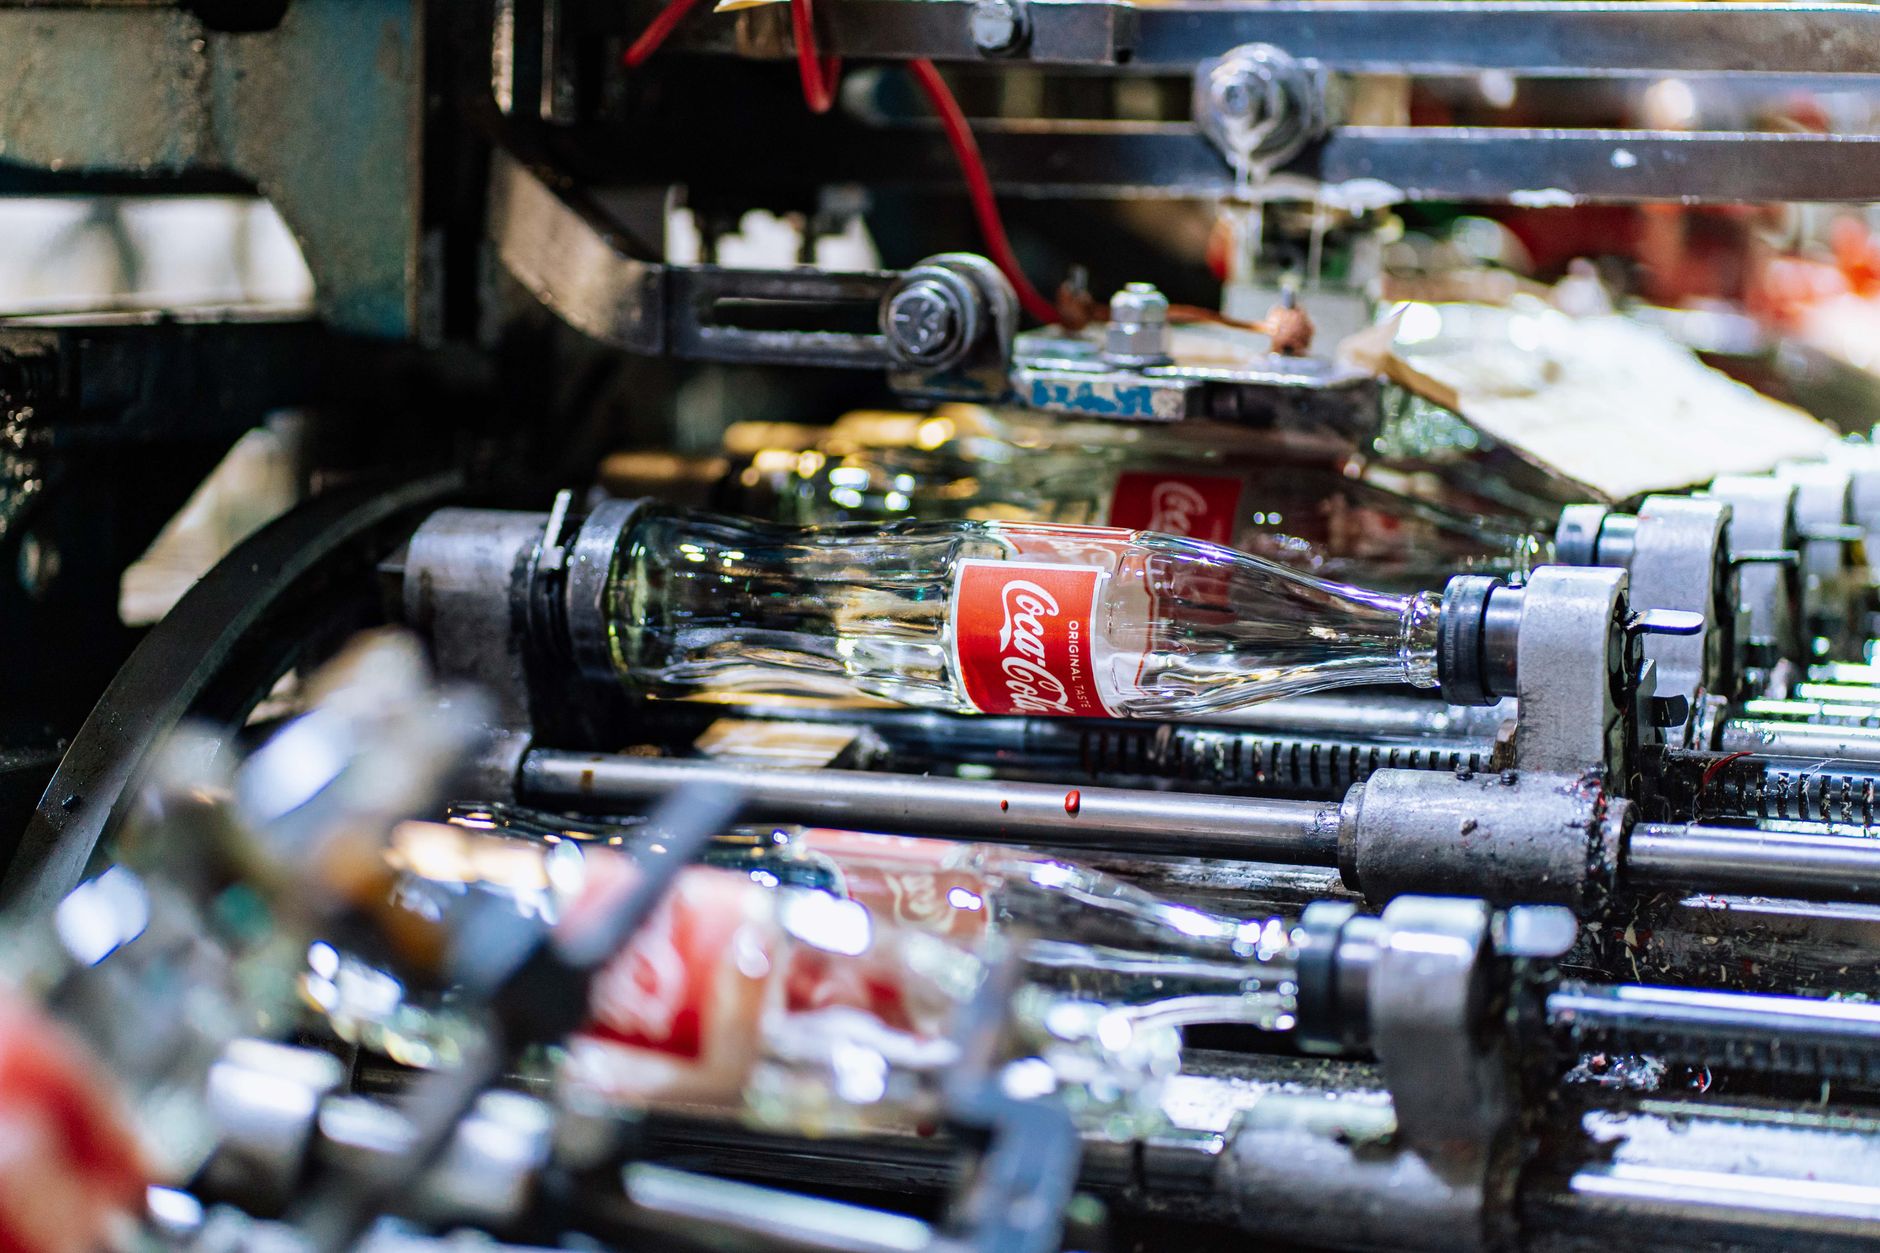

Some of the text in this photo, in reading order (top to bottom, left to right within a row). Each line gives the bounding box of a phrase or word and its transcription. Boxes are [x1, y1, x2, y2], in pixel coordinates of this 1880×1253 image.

[1000, 579, 1076, 714] Coca-Cola
[1068, 620, 1091, 709] ORIGINAL TASTE
